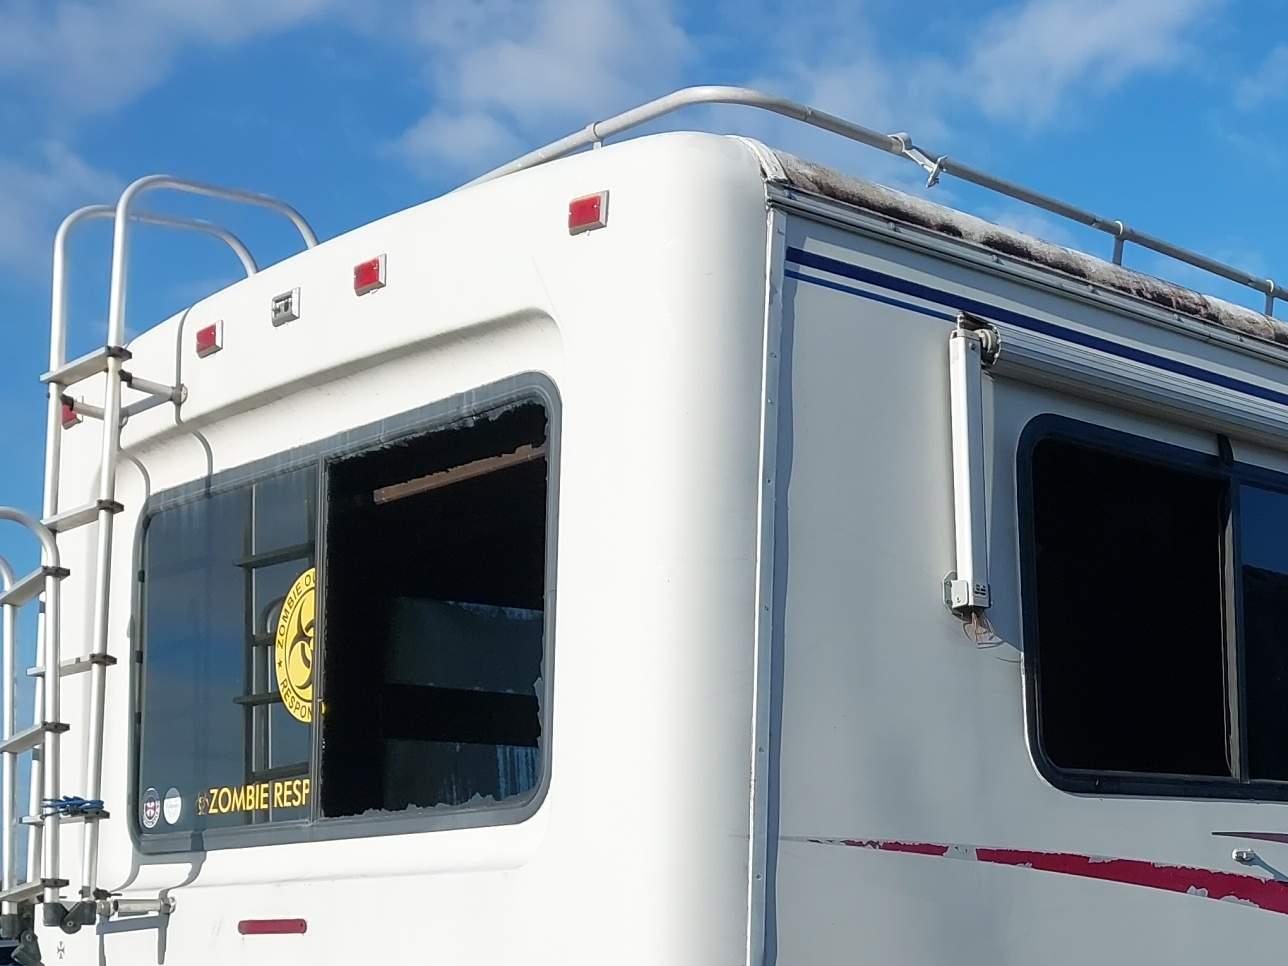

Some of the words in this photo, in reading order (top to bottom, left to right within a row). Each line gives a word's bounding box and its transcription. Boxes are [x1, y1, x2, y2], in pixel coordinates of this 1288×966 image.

[277, 582, 303, 649] ZOMBIE
[207, 782, 270, 815] ZOMBIE
[273, 778, 311, 809] RESP
